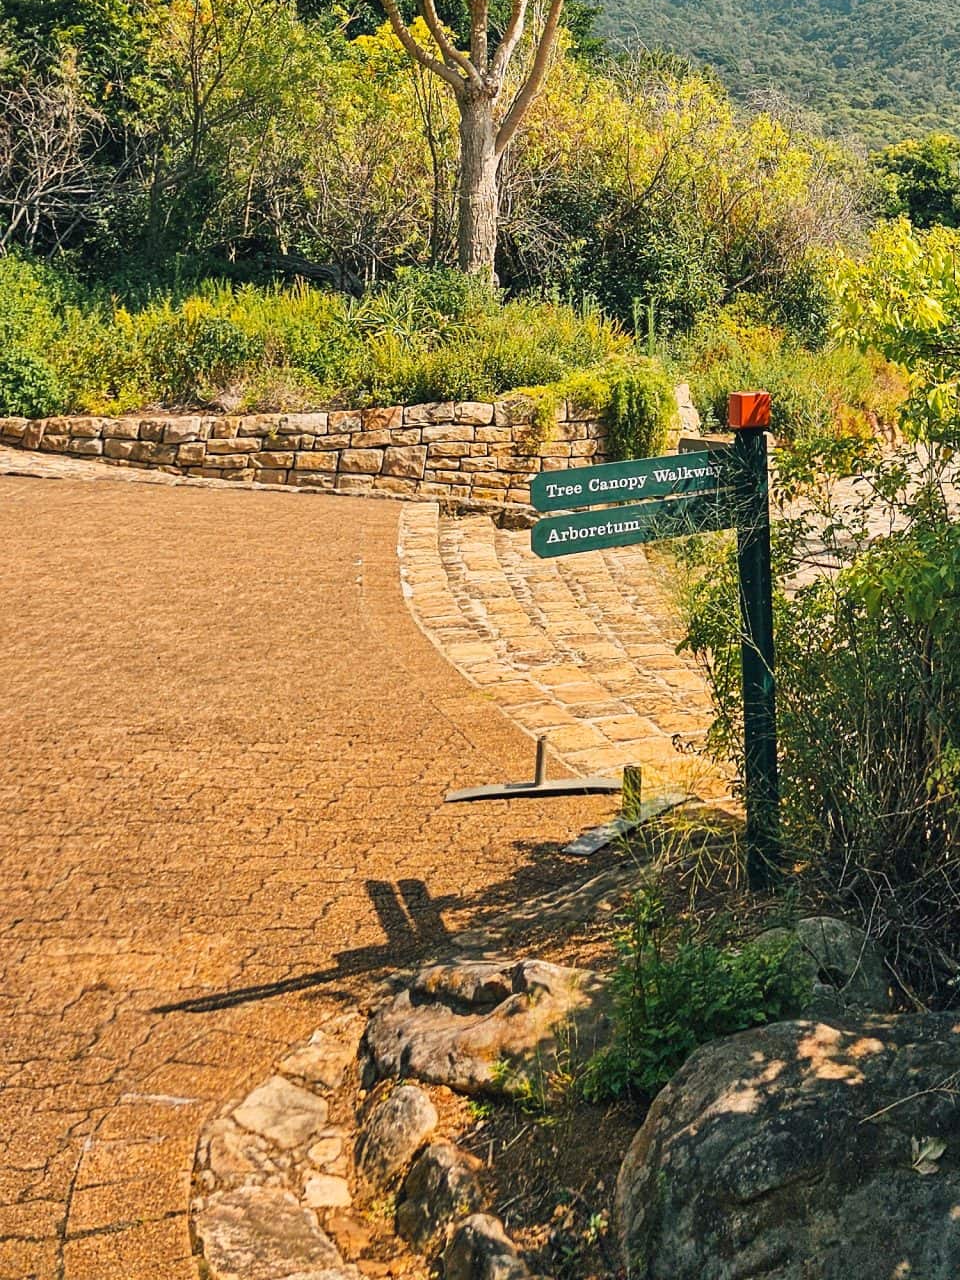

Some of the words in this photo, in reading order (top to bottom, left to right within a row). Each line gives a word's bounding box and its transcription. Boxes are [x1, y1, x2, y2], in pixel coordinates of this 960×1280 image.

[546, 483, 583, 498] Tree
[588, 474, 648, 493] Canopy
[653, 465, 723, 483] Walkway
[546, 519, 640, 544] Arboretum
